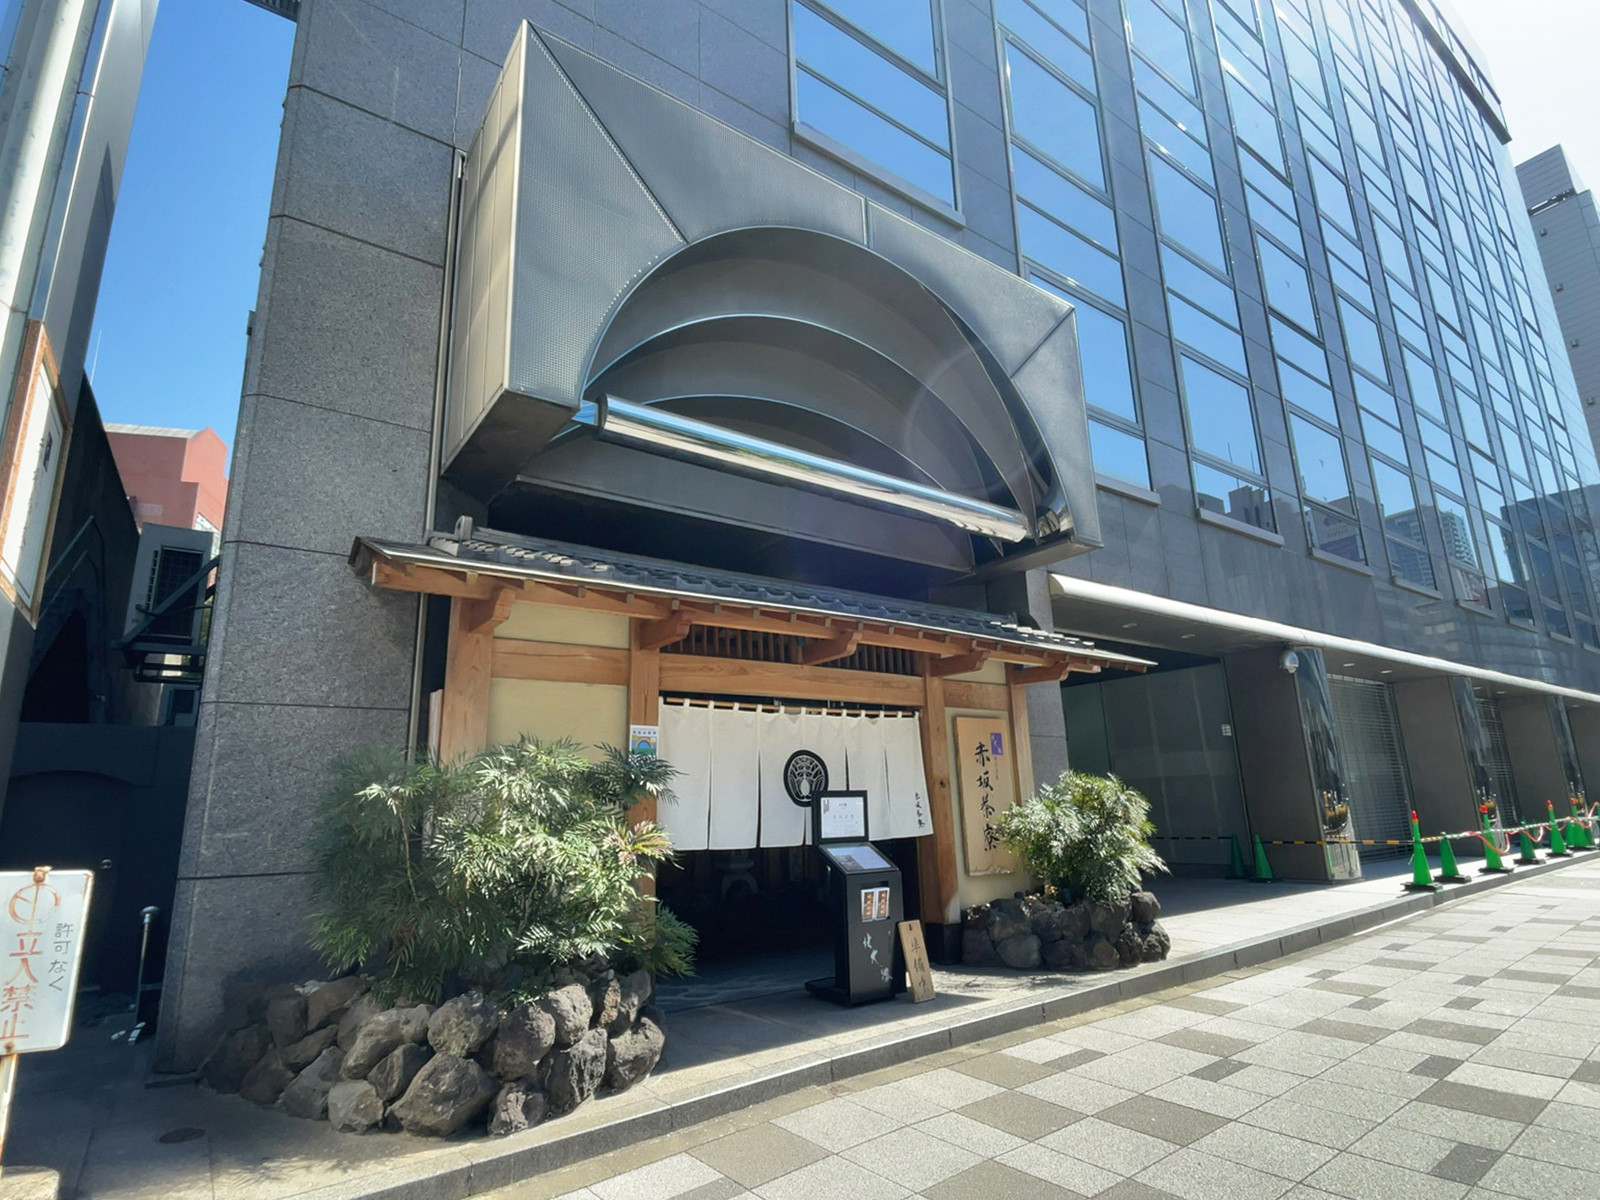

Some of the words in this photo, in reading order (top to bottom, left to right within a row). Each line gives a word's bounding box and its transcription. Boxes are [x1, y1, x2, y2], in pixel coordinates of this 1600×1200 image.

[0, 931, 43, 1039] 立入禁止
[48, 922, 74, 992] 許可なく
